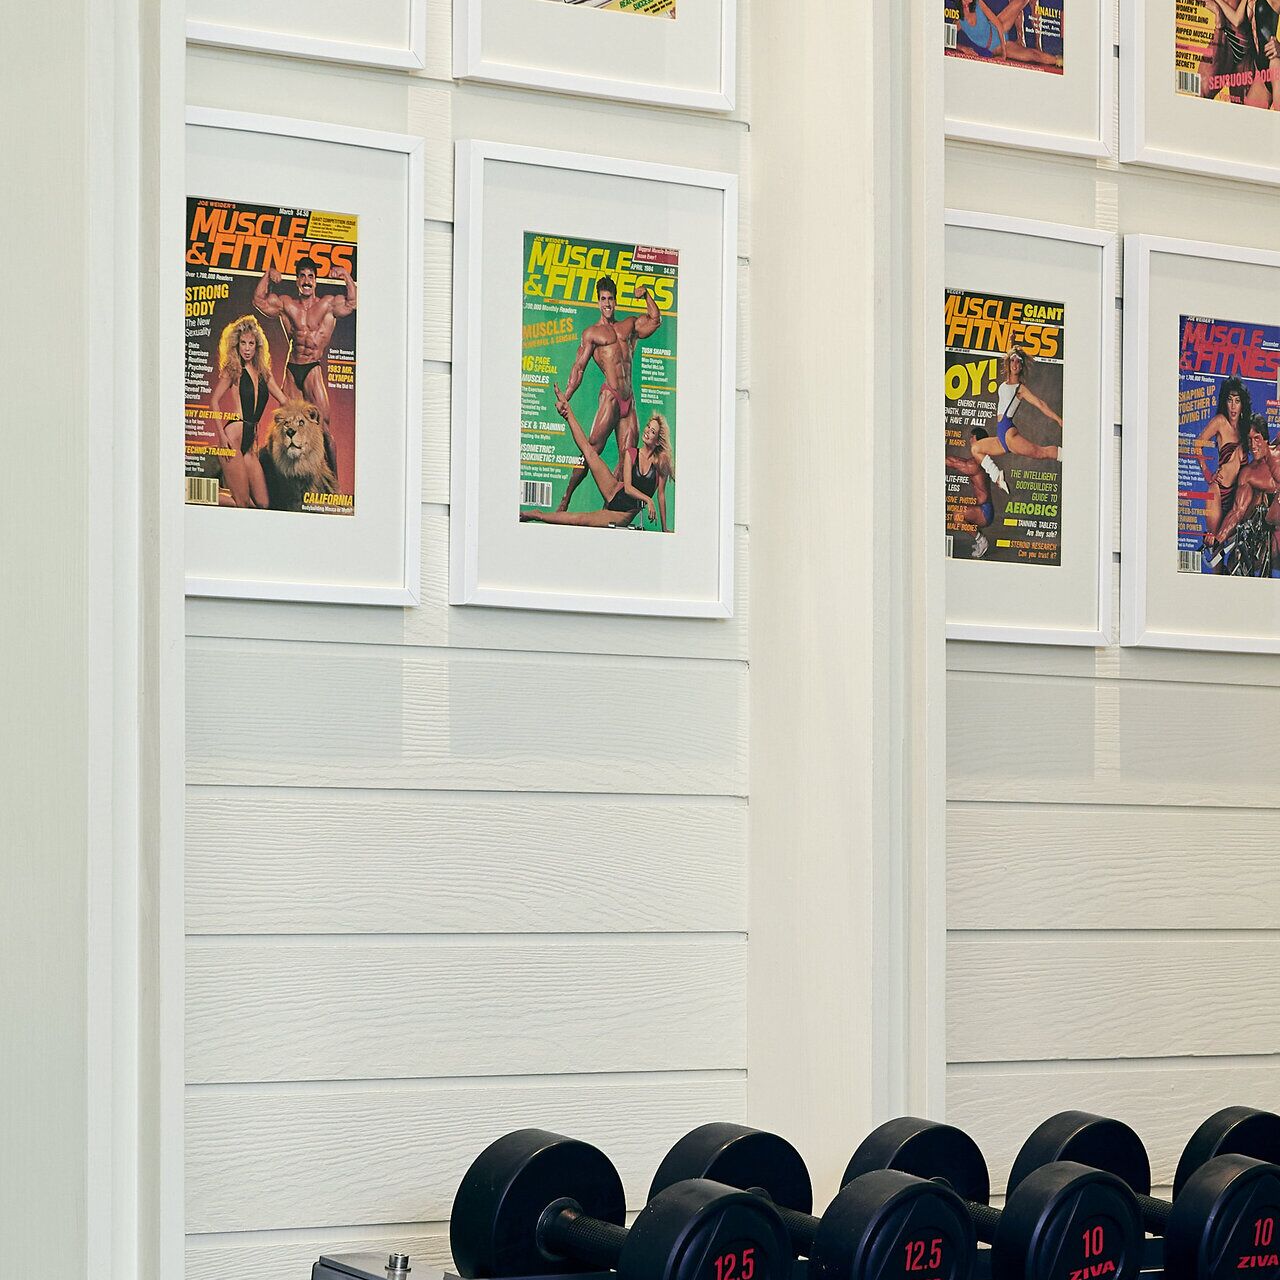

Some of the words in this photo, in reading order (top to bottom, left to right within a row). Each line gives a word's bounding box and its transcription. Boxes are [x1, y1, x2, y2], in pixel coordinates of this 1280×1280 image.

[1035, 5, 1060, 18] FINALLY!
[1176, 13, 1208, 24] BODYBUILDING
[1209, 70, 1253, 90] SENSUOUS
[210, 201, 236, 209] WEIDER'S
[279, 208, 294, 216] March
[190, 207, 307, 242] MUSCLE
[186, 242, 209, 266] &
[210, 232, 353, 278] FITNESS
[528, 241, 634, 275] MUSCLE
[185, 283, 229, 301] STRONG
[524, 274, 545, 297] &
[185, 301, 216, 317] BODY
[1024, 304, 1064, 320] GIANT
[185, 318, 196, 327] The
[197, 317, 210, 326] New
[523, 318, 573, 339] MUSCLES
[185, 327, 211, 337] Sexuality
[946, 316, 1059, 357] FITNESS
[1182, 321, 1264, 352] MUSCLE
[535, 356, 550, 365] PAGE
[1179, 351, 1193, 370] &
[535, 364, 558, 374] SPECIAL
[328, 374, 354, 383] OLYMPIA
[521, 374, 549, 384] MUSCLES
[945, 358, 997, 400] OY!
[1179, 387, 1205, 400] SHAPING
[1207, 385, 1215, 395] UP
[1179, 397, 1210, 413] TOGETHER
[1212, 397, 1216, 406] &
[199, 411, 222, 420] DIETING
[222, 412, 240, 421] FAILS
[962, 408, 976, 417] GREAT
[1179, 411, 1200, 425] LOVING
[1201, 408, 1210, 420] IT!
[971, 418, 986, 426] ALL!
[1023, 471, 1057, 481] INTELLIGENT
[1016, 481, 1058, 492] BODYBUILDER'S
[303, 492, 353, 506] CALIFORNIA
[1032, 492, 1048, 501] GUIDE
[1005, 502, 1058, 516] AEROBICS
[1018, 519, 1037, 528] TANNING
[1038, 521, 1057, 529] TABLETS
[1045, 530, 1057, 538] safe?
[1031, 542, 1056, 550] RESEARCH
[1254, 1217, 1274, 1247] 10
[1083, 1225, 1104, 1259] 10
[905, 1238, 942, 1271] 12.5
[1236, 1253, 1280, 1269] ZIVA
